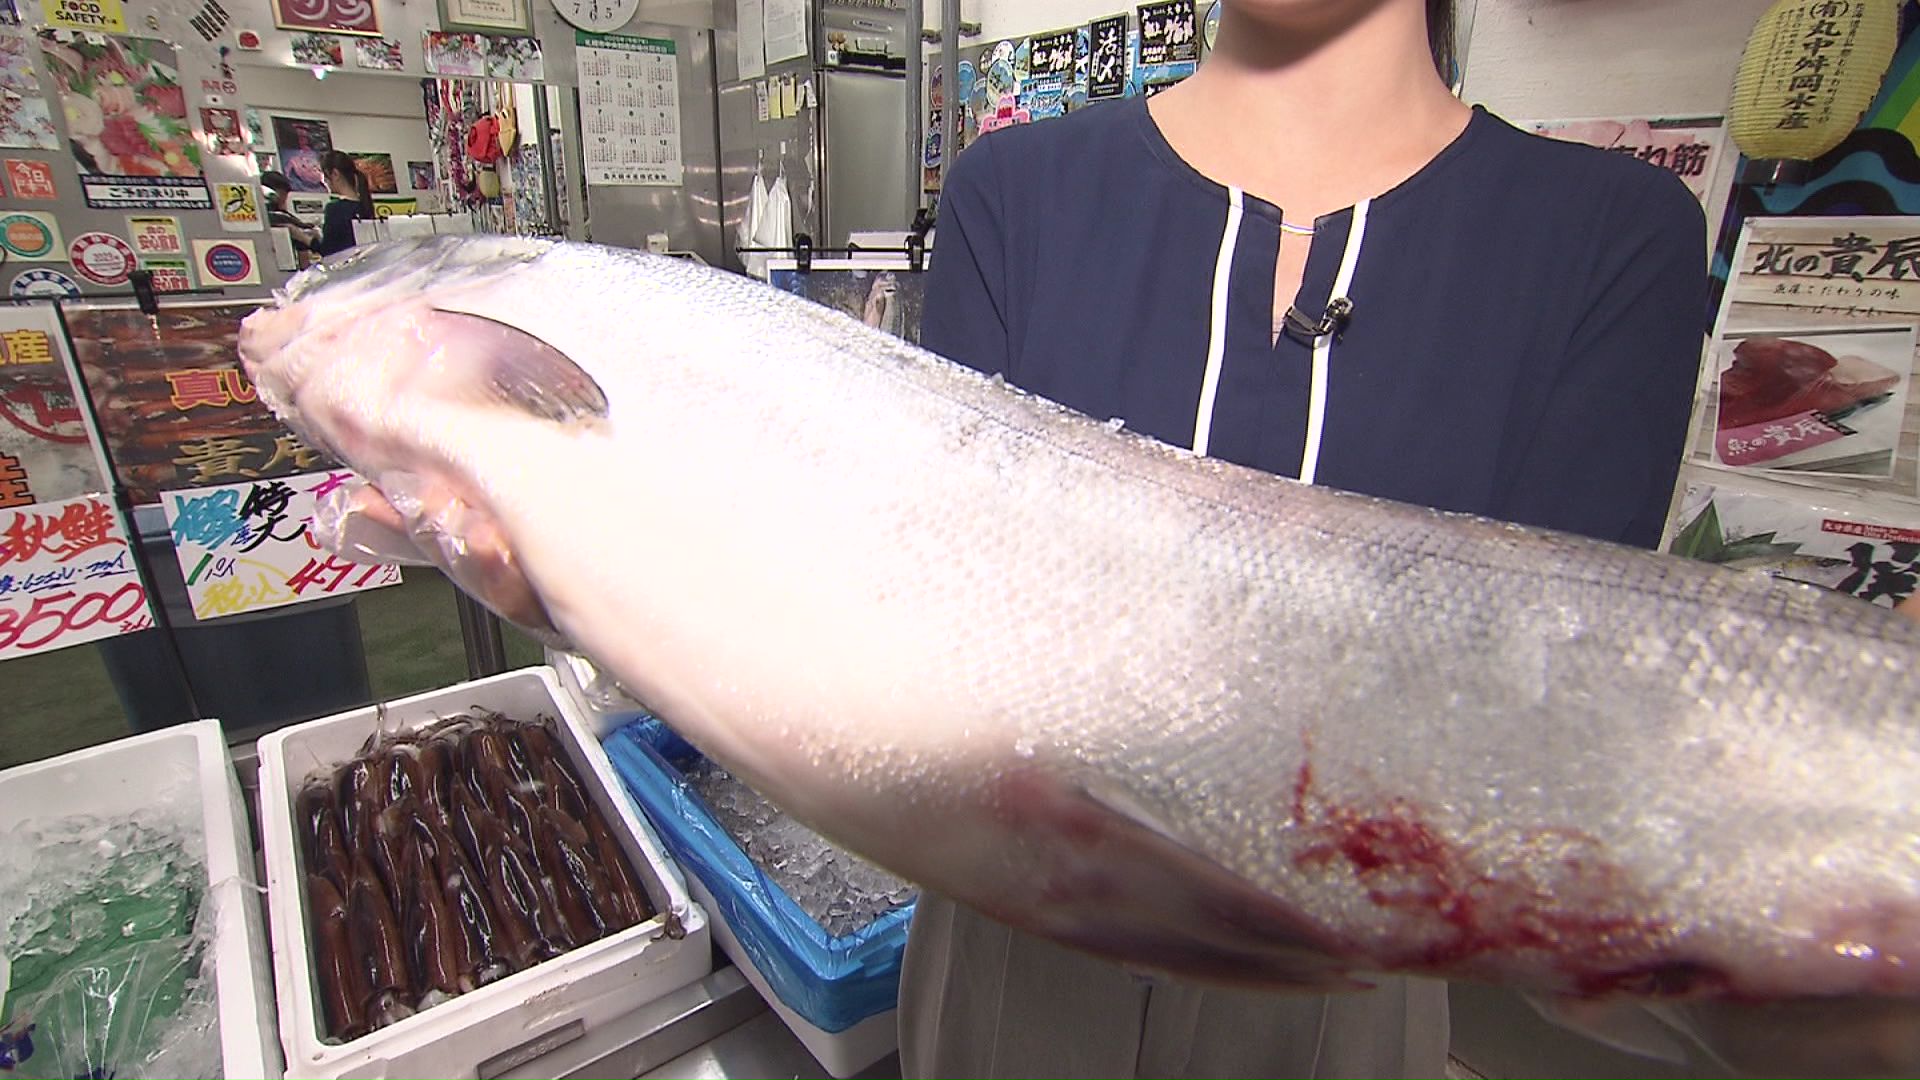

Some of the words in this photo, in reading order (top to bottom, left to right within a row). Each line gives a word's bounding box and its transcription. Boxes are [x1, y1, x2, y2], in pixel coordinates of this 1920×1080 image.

[61, 1, 100, 13] FOOD
[55, 10, 106, 24] SAFETY
[0, 329, 53, 364] 産
